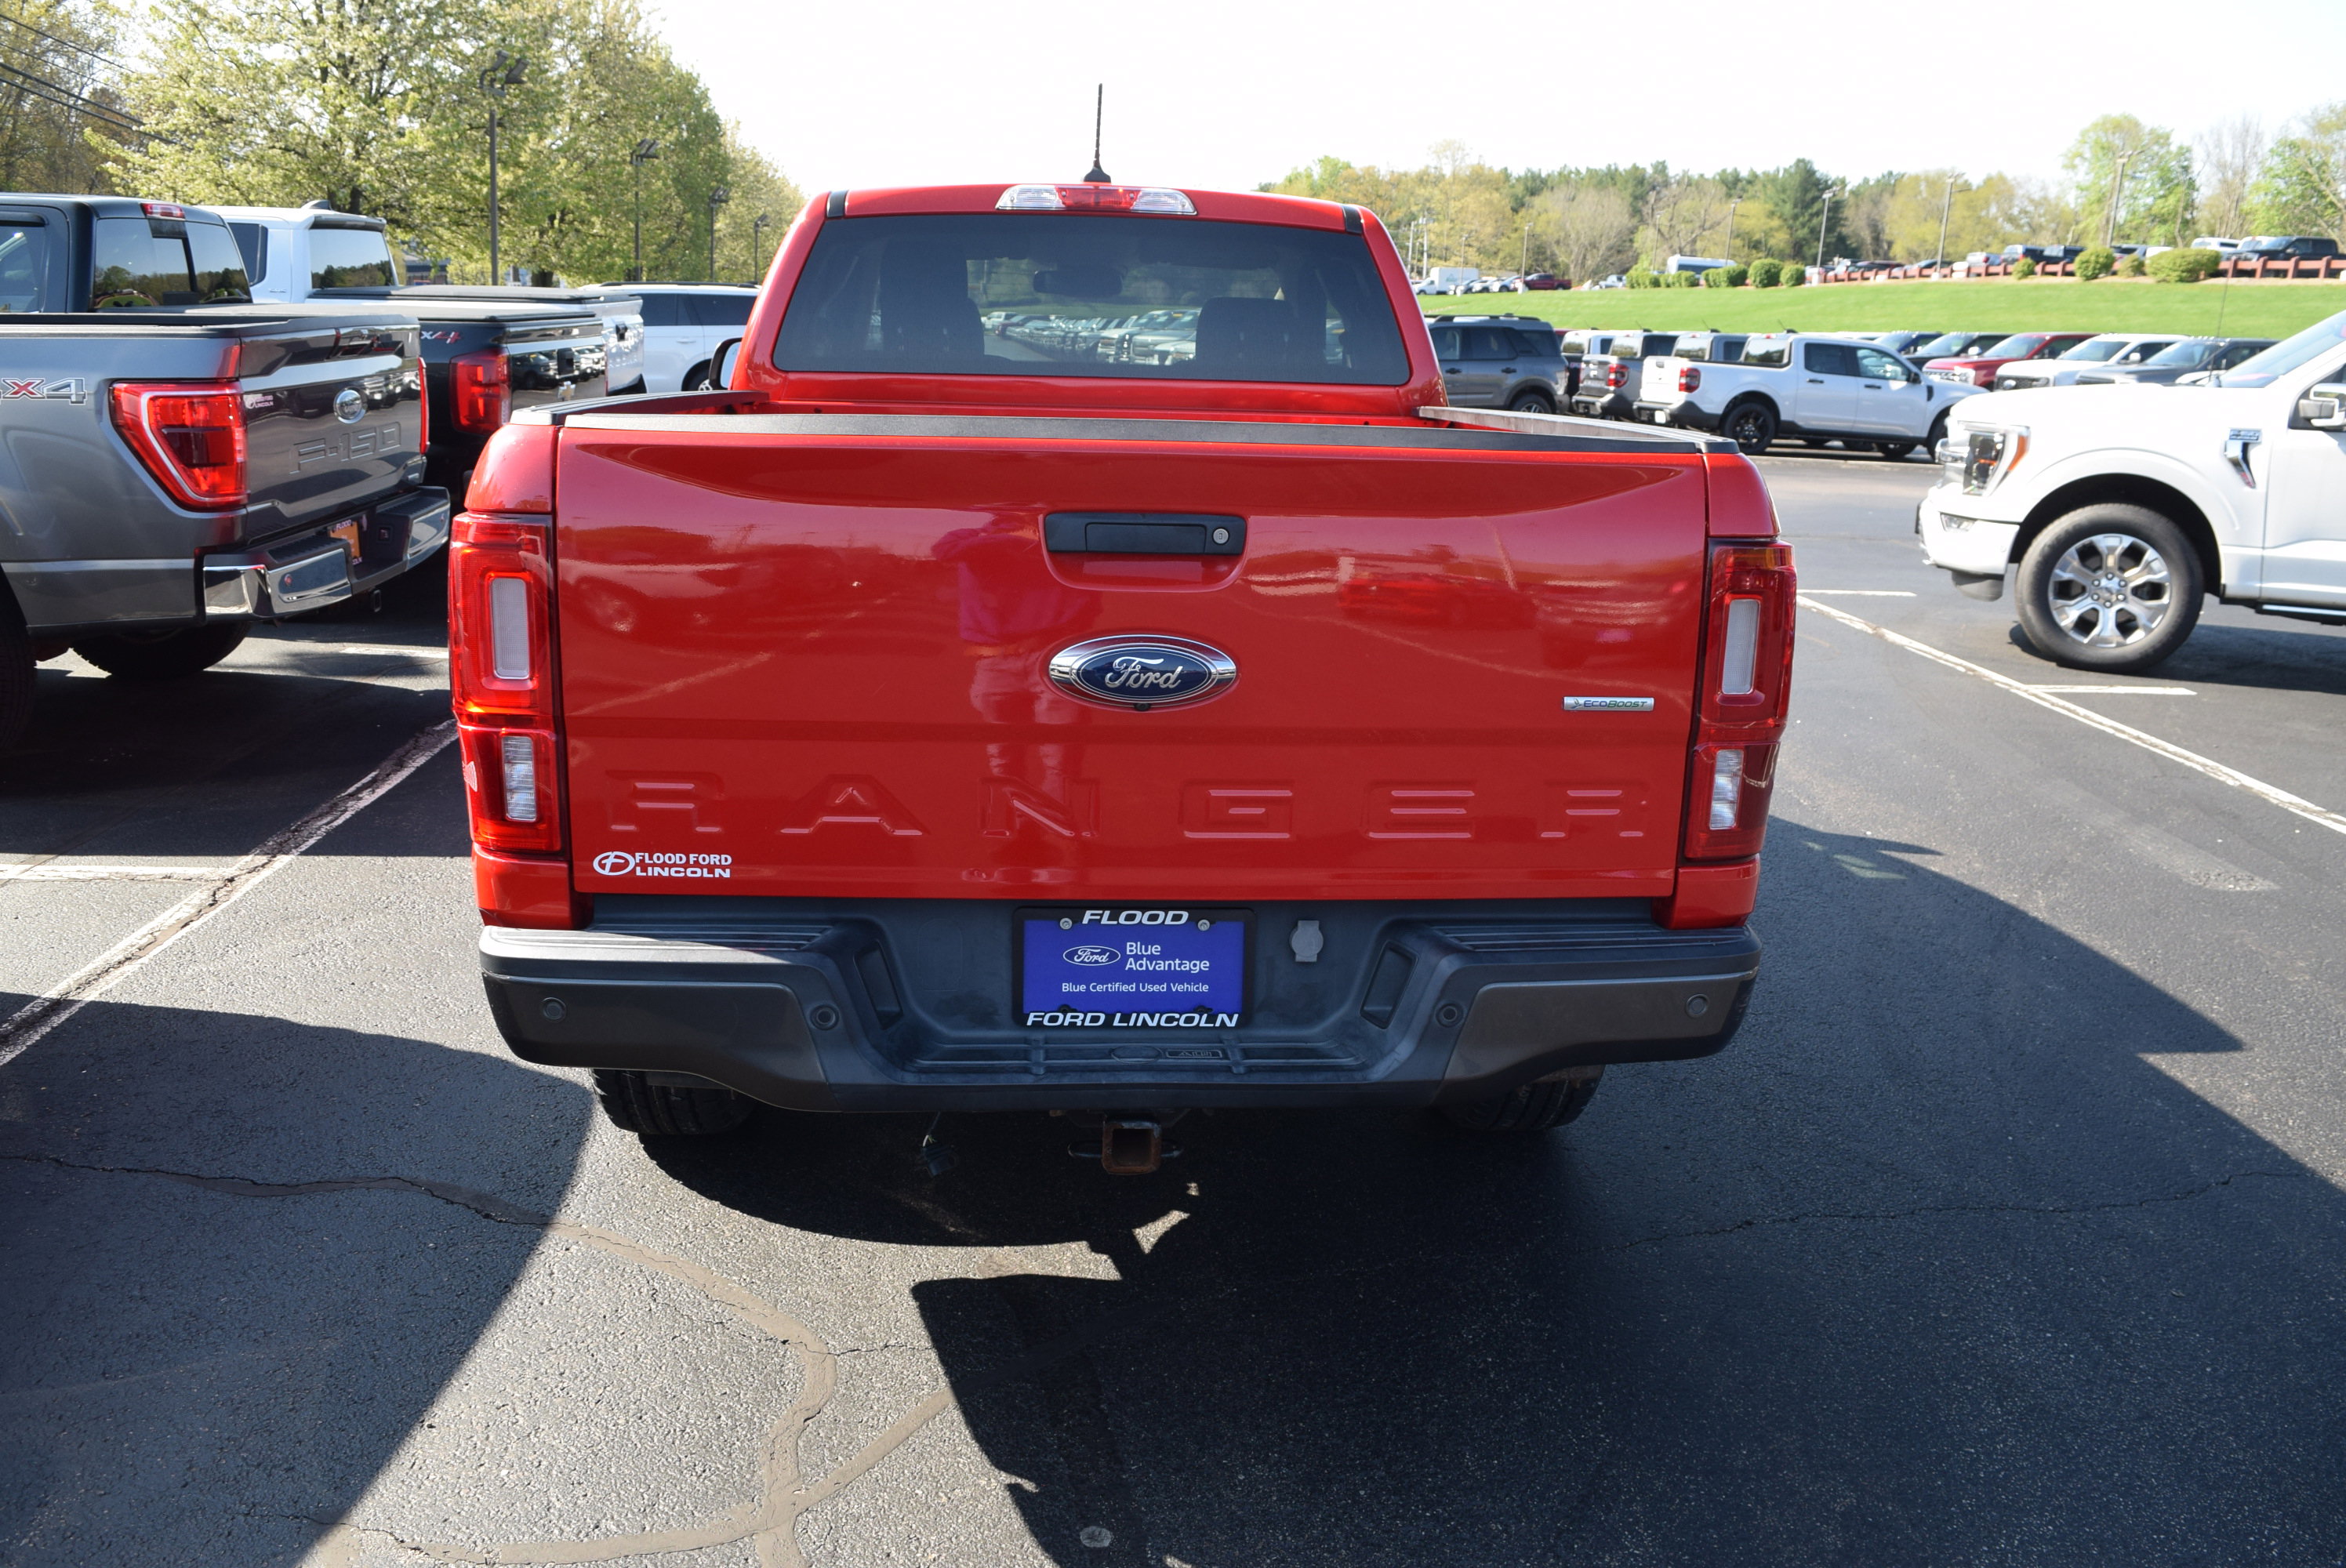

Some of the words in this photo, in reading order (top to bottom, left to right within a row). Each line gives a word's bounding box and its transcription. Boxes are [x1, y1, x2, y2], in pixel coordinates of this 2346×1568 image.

[419, 331, 461, 344] X4
[0, 377, 87, 406] X4
[289, 421, 401, 475] F-150
[1105, 656, 1183, 688] Ford
[605, 769, 1646, 842] RANGER
[634, 852, 687, 864] FLOOD
[689, 853, 732, 865] FORD
[635, 866, 731, 878] LINCOLN
[1081, 909, 1189, 925] FLOOD
[1073, 947, 1109, 963] Ford
[1125, 942, 1161, 955] Blue
[1124, 958, 1210, 973] Advantage
[1062, 982, 1086, 992] Blue
[1089, 982, 1136, 993] Certified
[1139, 982, 1167, 993] Used
[1170, 982, 1209, 993] Vehicle
[1026, 1012, 1106, 1026] FORD
[1112, 1012, 1239, 1027] LINCOLN
